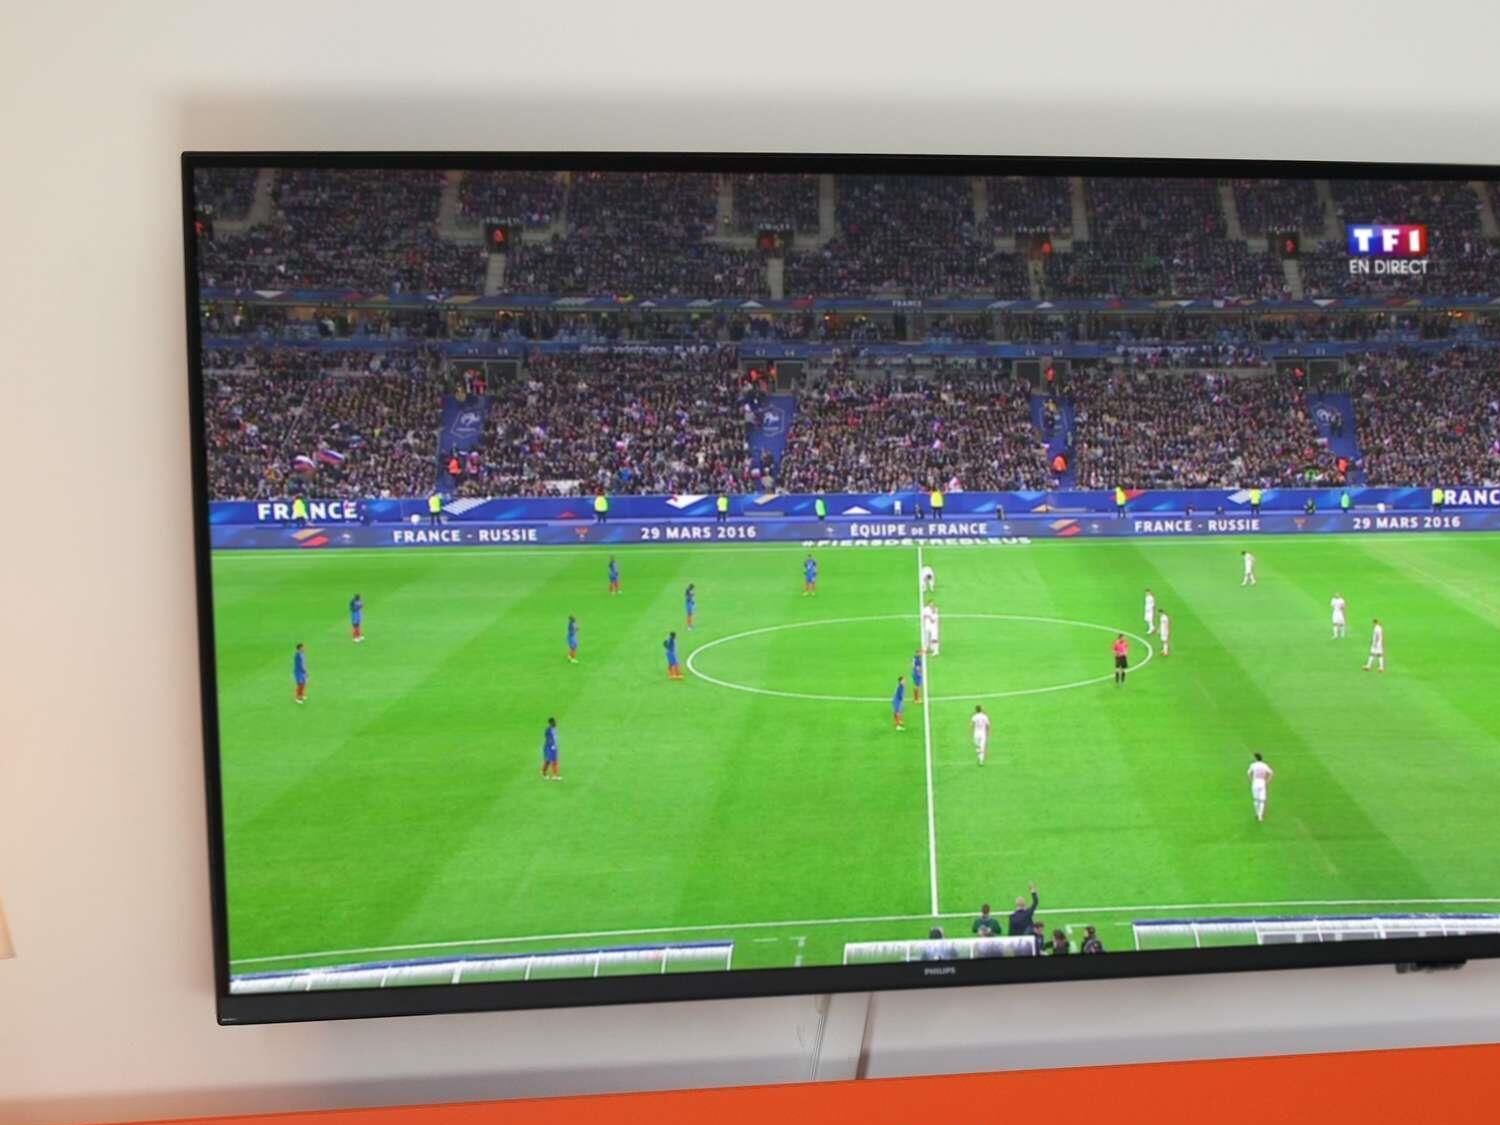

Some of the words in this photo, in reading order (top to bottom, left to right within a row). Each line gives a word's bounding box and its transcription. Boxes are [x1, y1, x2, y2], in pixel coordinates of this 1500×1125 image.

[1353, 228, 1420, 252] TF1
[1349, 259, 1370, 274] EN
[1374, 259, 1428, 274] DIRECT
[850, 520, 907, 538] ÉQUIPE
[928, 522, 987, 535] FRANCE
[1134, 520, 1193, 532] FRANCE
[1208, 519, 1260, 532] RUSSIE
[1353, 517, 1371, 530] 29
[1376, 516, 1419, 529] MARS
[1424, 516, 1461, 529] 2016
[393, 529, 461, 543] FRANCE
[478, 528, 537, 542] RUSSIE
[641, 527, 661, 540] 29
[666, 526, 711, 539] MARS
[717, 526, 757, 539] 2016
